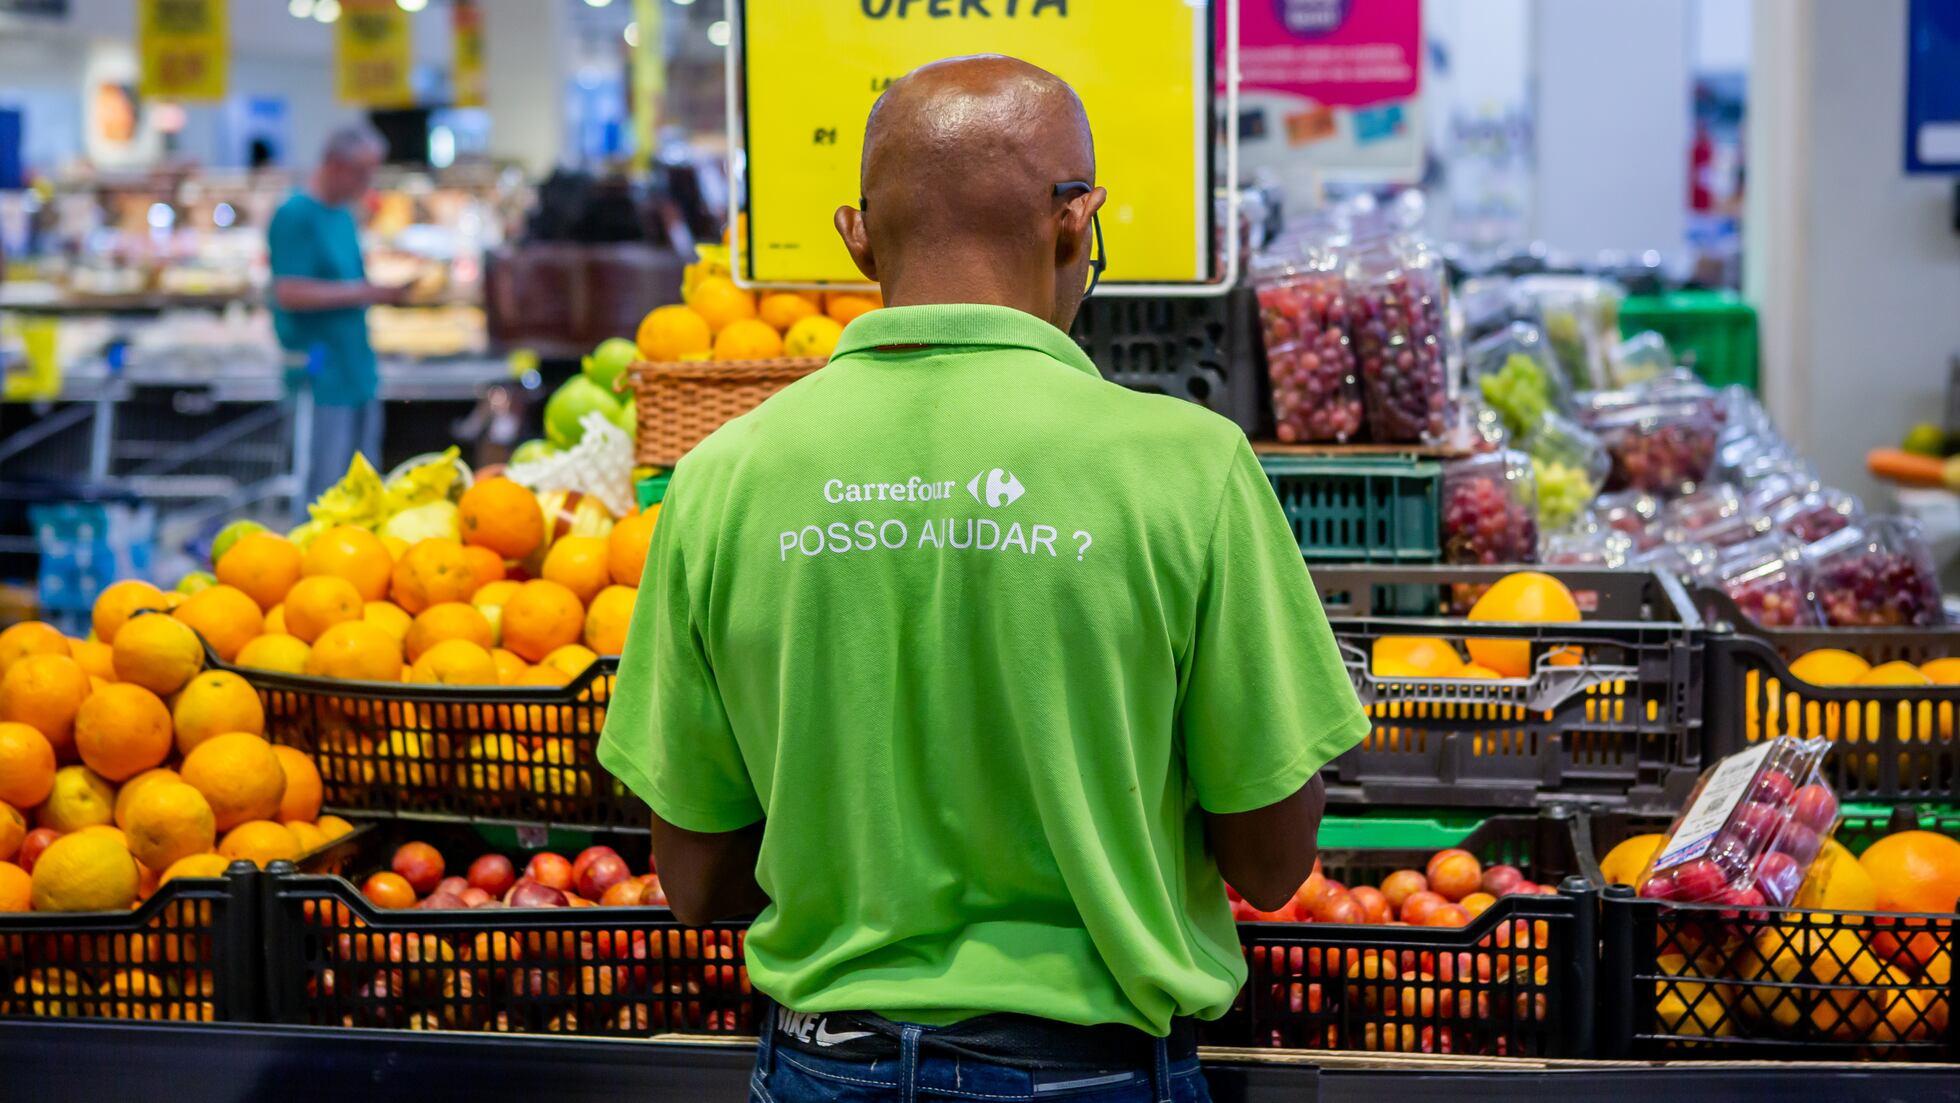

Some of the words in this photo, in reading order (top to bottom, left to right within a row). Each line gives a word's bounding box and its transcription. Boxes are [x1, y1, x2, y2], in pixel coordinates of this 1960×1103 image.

[823, 476, 956, 504] Carrefour
[779, 518, 908, 562] POSSO
[917, 517, 1058, 558] AJUDAR
[1072, 529, 1093, 562] ?
